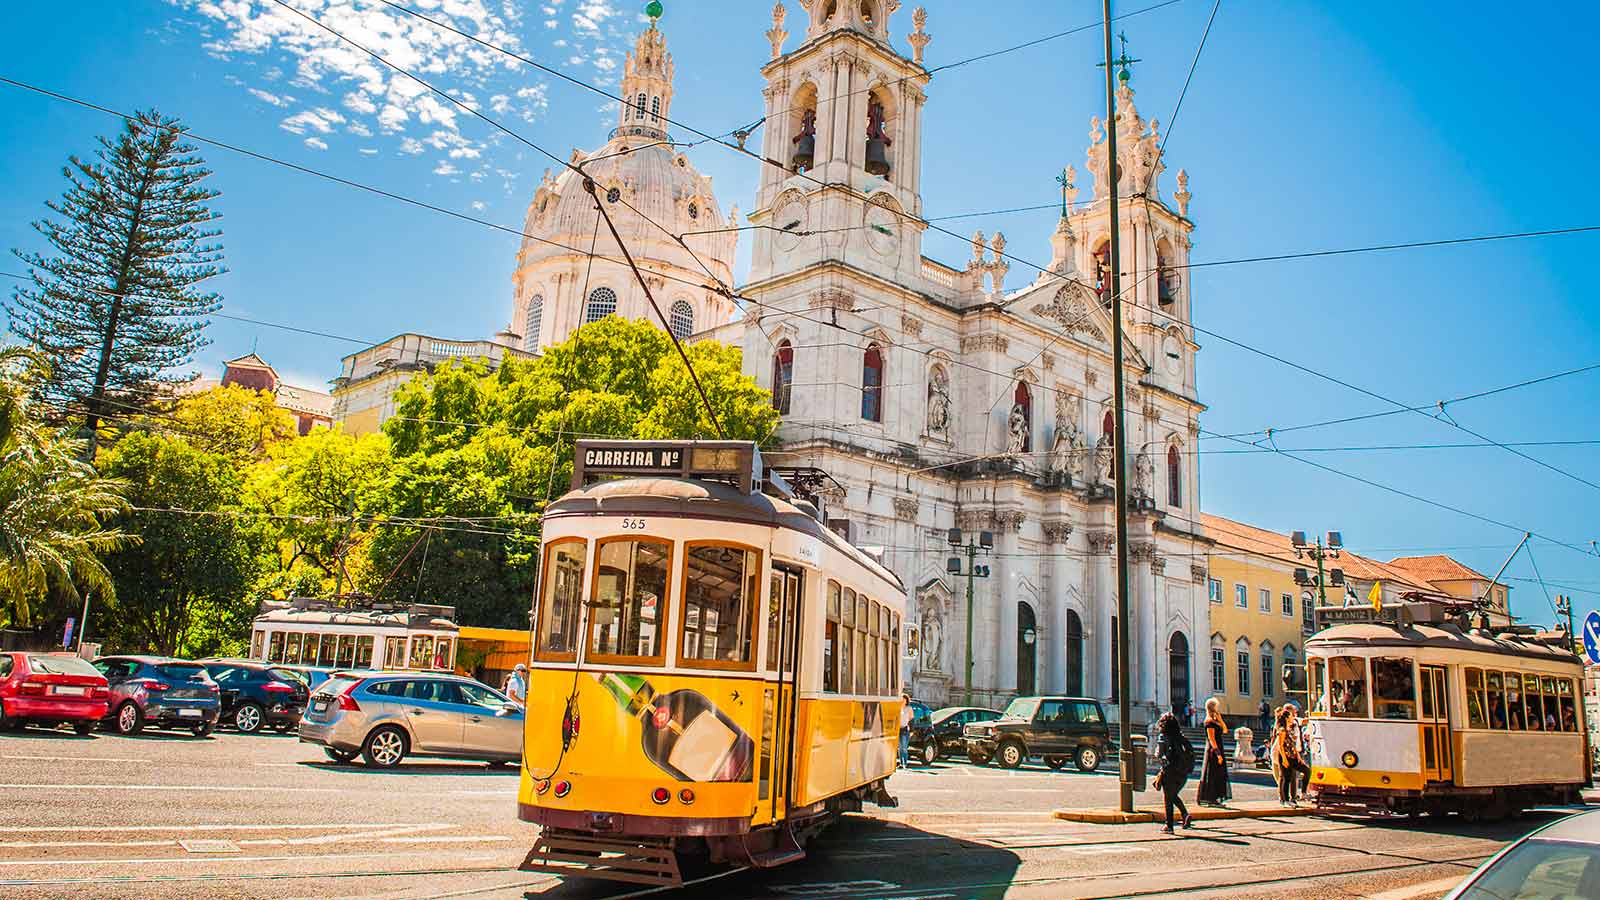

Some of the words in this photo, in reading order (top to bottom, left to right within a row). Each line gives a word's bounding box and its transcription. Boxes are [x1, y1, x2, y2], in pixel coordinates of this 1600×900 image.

[585, 450, 654, 465] CARREIRA
[661, 451, 679, 466] Nº
[622, 518, 646, 529] 565
